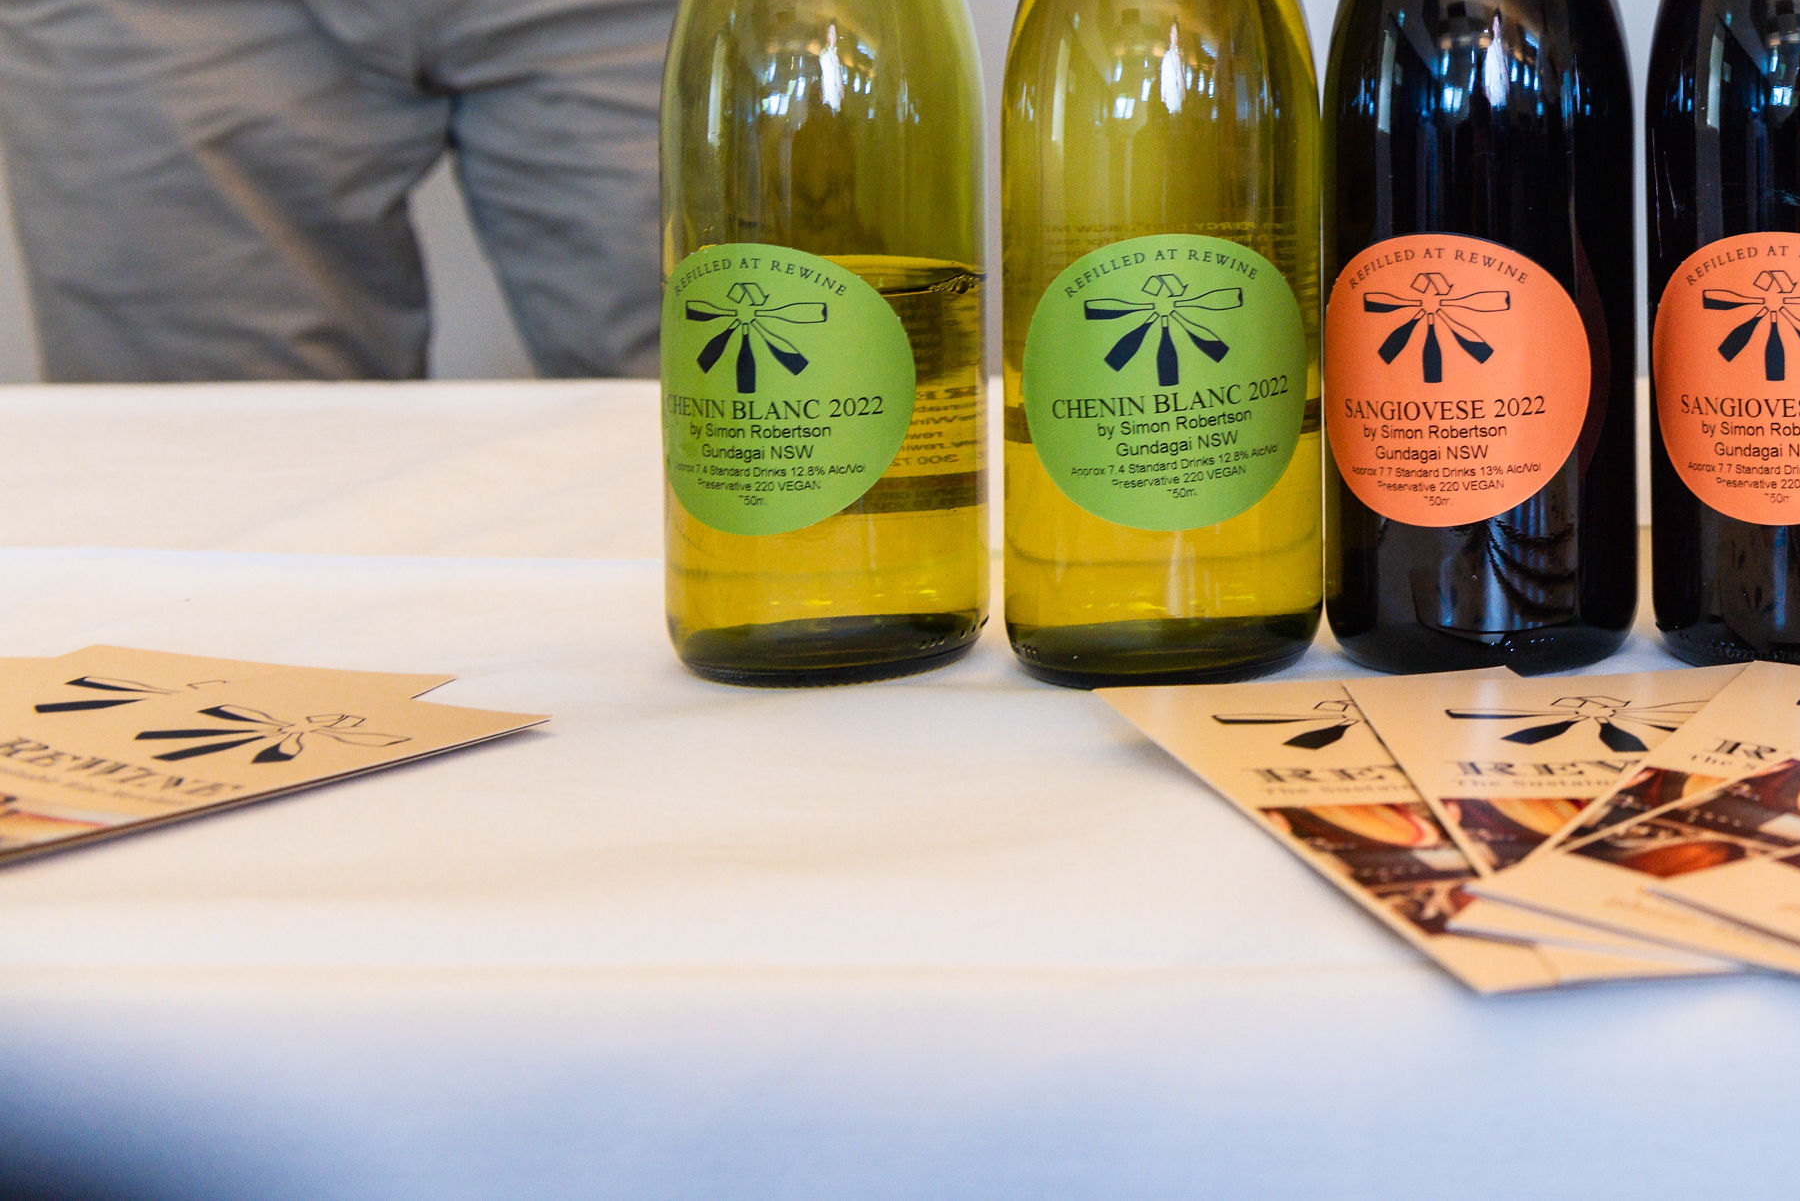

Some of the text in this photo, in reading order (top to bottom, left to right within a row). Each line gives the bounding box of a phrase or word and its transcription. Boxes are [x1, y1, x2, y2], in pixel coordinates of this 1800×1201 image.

[1064, 249, 1258, 297] REFILLED AT REWINE
[1349, 247, 1528, 289] REFILLED AT REWINE
[1686, 246, 1758, 286] REFILLED
[1767, 245, 1789, 257] AT
[675, 257, 848, 297] REFILLED AT REWINE
[1052, 375, 1289, 419] CHENIN BLANC 2022
[732, 399, 820, 420] BLANC
[828, 395, 884, 418] 2022
[1345, 395, 1546, 421] SANGIOVESE 2022
[690, 422, 832, 439] by Simon Robertson
[1097, 408, 1252, 439] by Simon Robertson
[1363, 424, 1507, 441] by Simon Robertson
[1701, 420, 1716, 437] by
[1720, 421, 1765, 436] Simon
[1116, 429, 1238, 457] Gundagai NSW
[1714, 441, 1784, 460] Gundagai
[701, 444, 814, 463] Gundagai NSW
[1108, 464, 1125, 476] 7.4
[1128, 461, 1177, 474] Standard
[1181, 456, 1215, 469] Drinks
[1219, 451, 1248, 463] 12.8%
[1251, 444, 1278, 458] Alc/Vo
[1375, 445, 1489, 464] Gundagai NSW
[709, 465, 750, 477] Standard
[753, 466, 787, 477] Drinks
[791, 465, 825, 477] 12.8%
[1112, 464, 1246, 489] Preservative 220 VEGAN
[1395, 467, 1439, 478] Standard
[1442, 467, 1476, 478] Drinks
[1480, 465, 1504, 476] 13%
[1735, 464, 1781, 475] Standard
[755, 481, 775, 491] 220
[777, 480, 821, 491] VEGAN
[1377, 479, 1505, 492] Preservative 220 VEGAN
[1716, 476, 1777, 489] Preservative
[1780, 478, 1800, 489] 220
[1453, 778, 1501, 788] The
